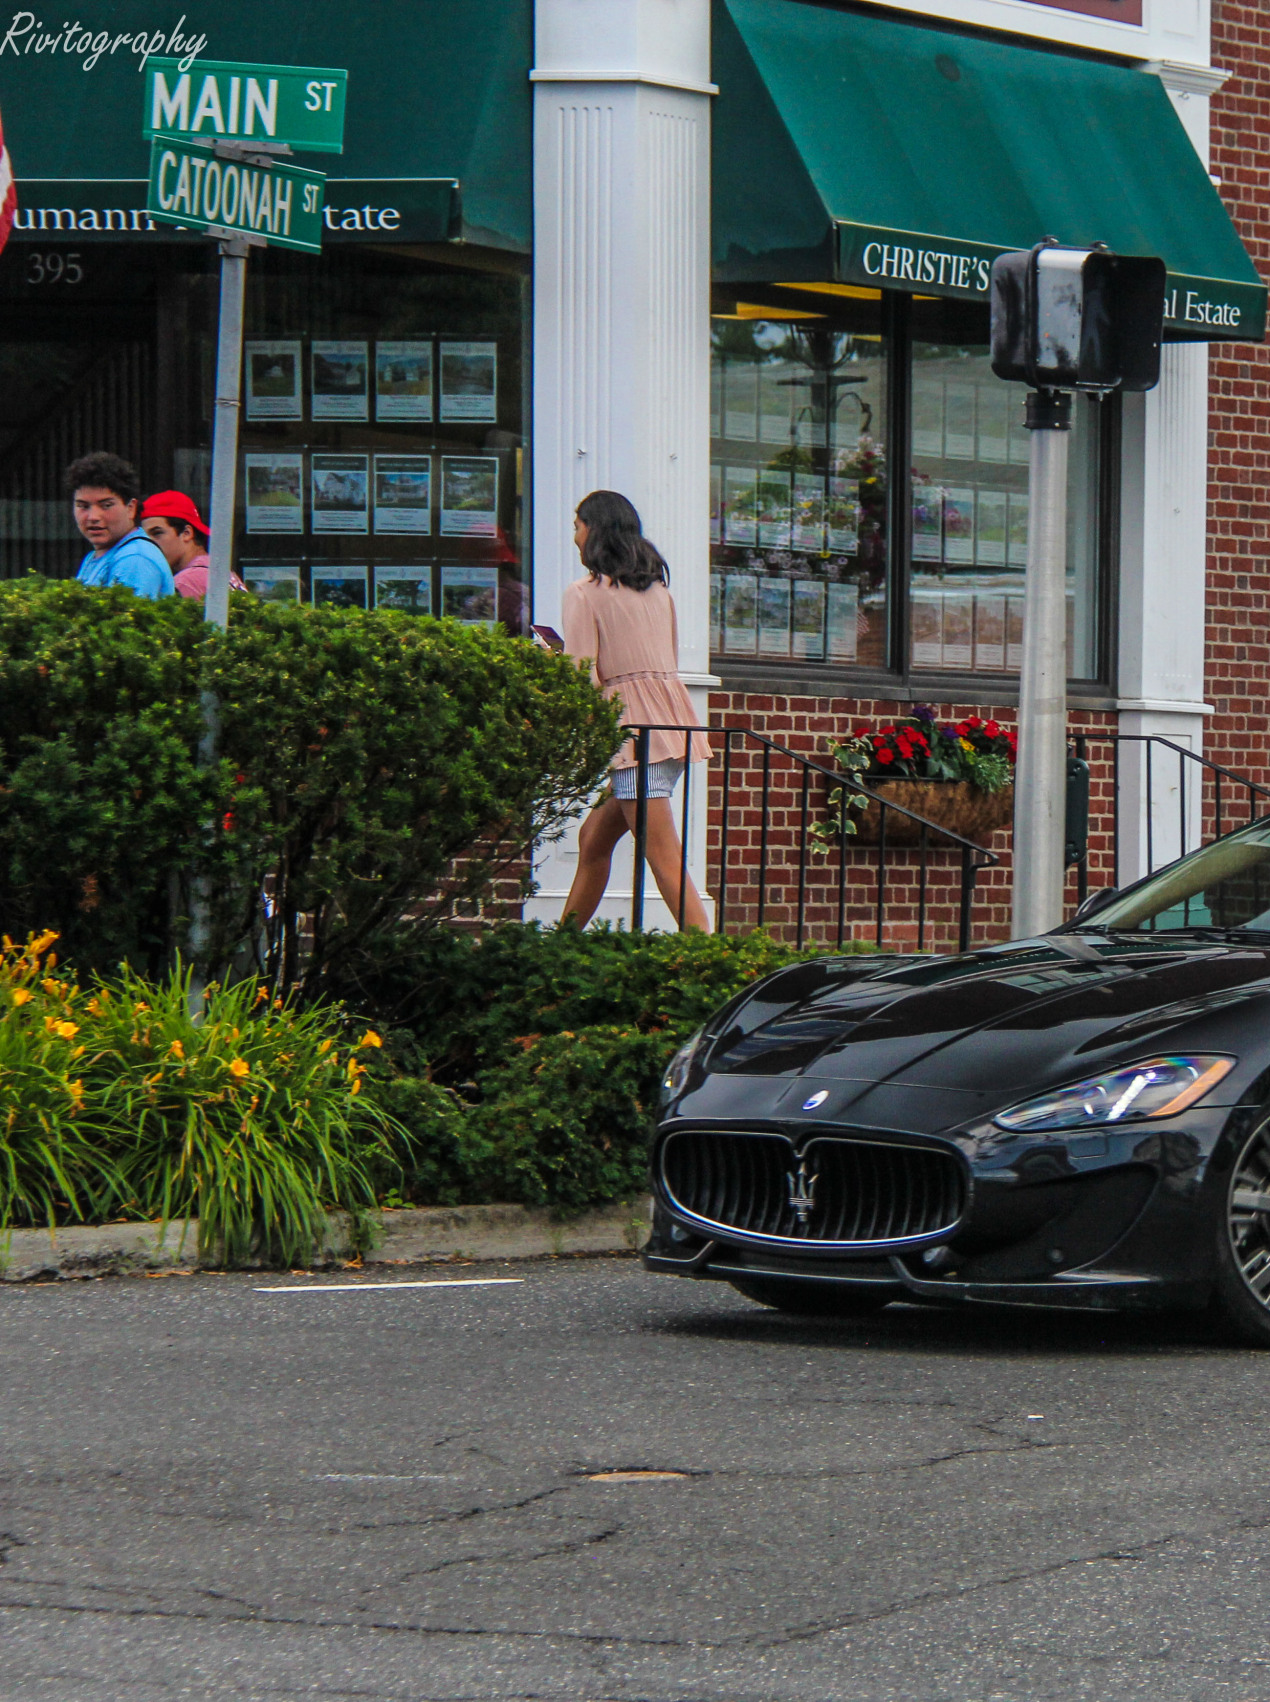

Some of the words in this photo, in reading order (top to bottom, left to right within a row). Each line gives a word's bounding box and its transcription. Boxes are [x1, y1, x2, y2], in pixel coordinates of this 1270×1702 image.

[151, 72, 278, 136] MAIN
[304, 81, 338, 112] ST
[13, 208, 157, 231] umann
[322, 204, 400, 231] tate
[158, 151, 293, 236] CATOONAH
[302, 183, 320, 214] ST
[27, 253, 84, 285] 395
[862, 242, 991, 292] CHRISTIE'S
[1184, 291, 1241, 327] Estate
